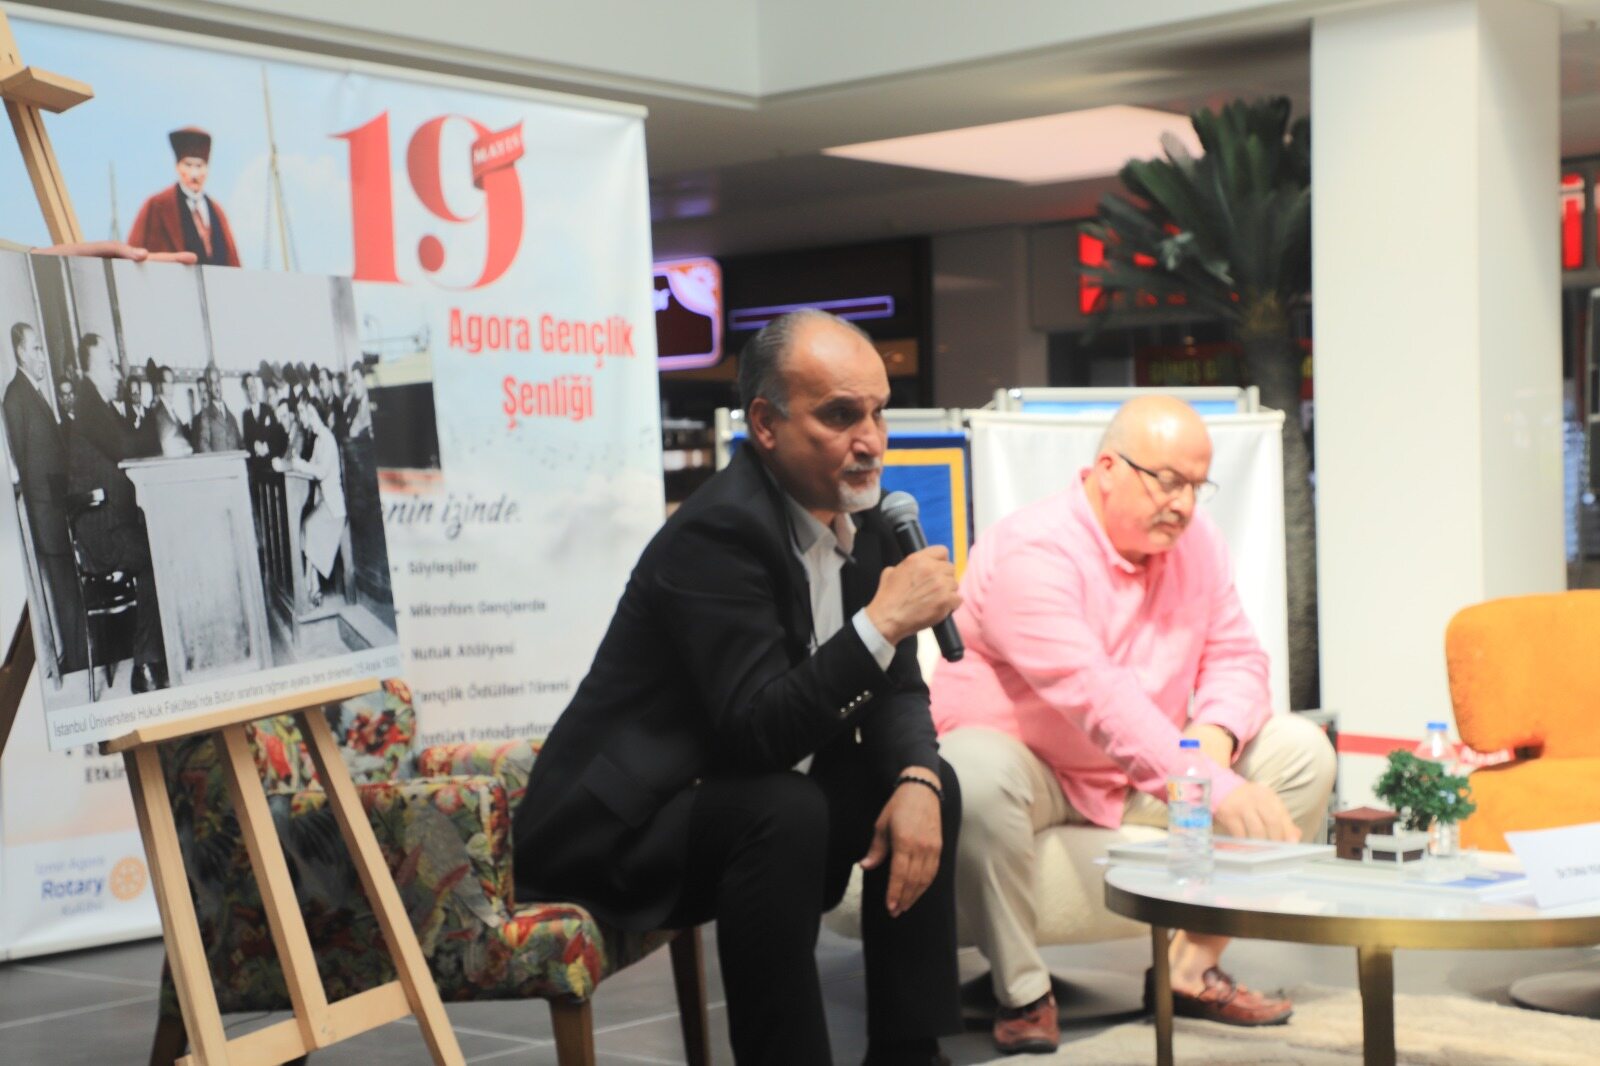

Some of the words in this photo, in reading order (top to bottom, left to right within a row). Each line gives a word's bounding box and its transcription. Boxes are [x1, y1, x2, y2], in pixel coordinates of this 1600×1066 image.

[326, 107, 527, 291] 19
[449, 307, 531, 354] Agora
[539, 311, 636, 370] Gençlik
[502, 375, 595, 431] Şenliği
[386, 493, 433, 524] nin
[41, 876, 105, 901] Rotary
